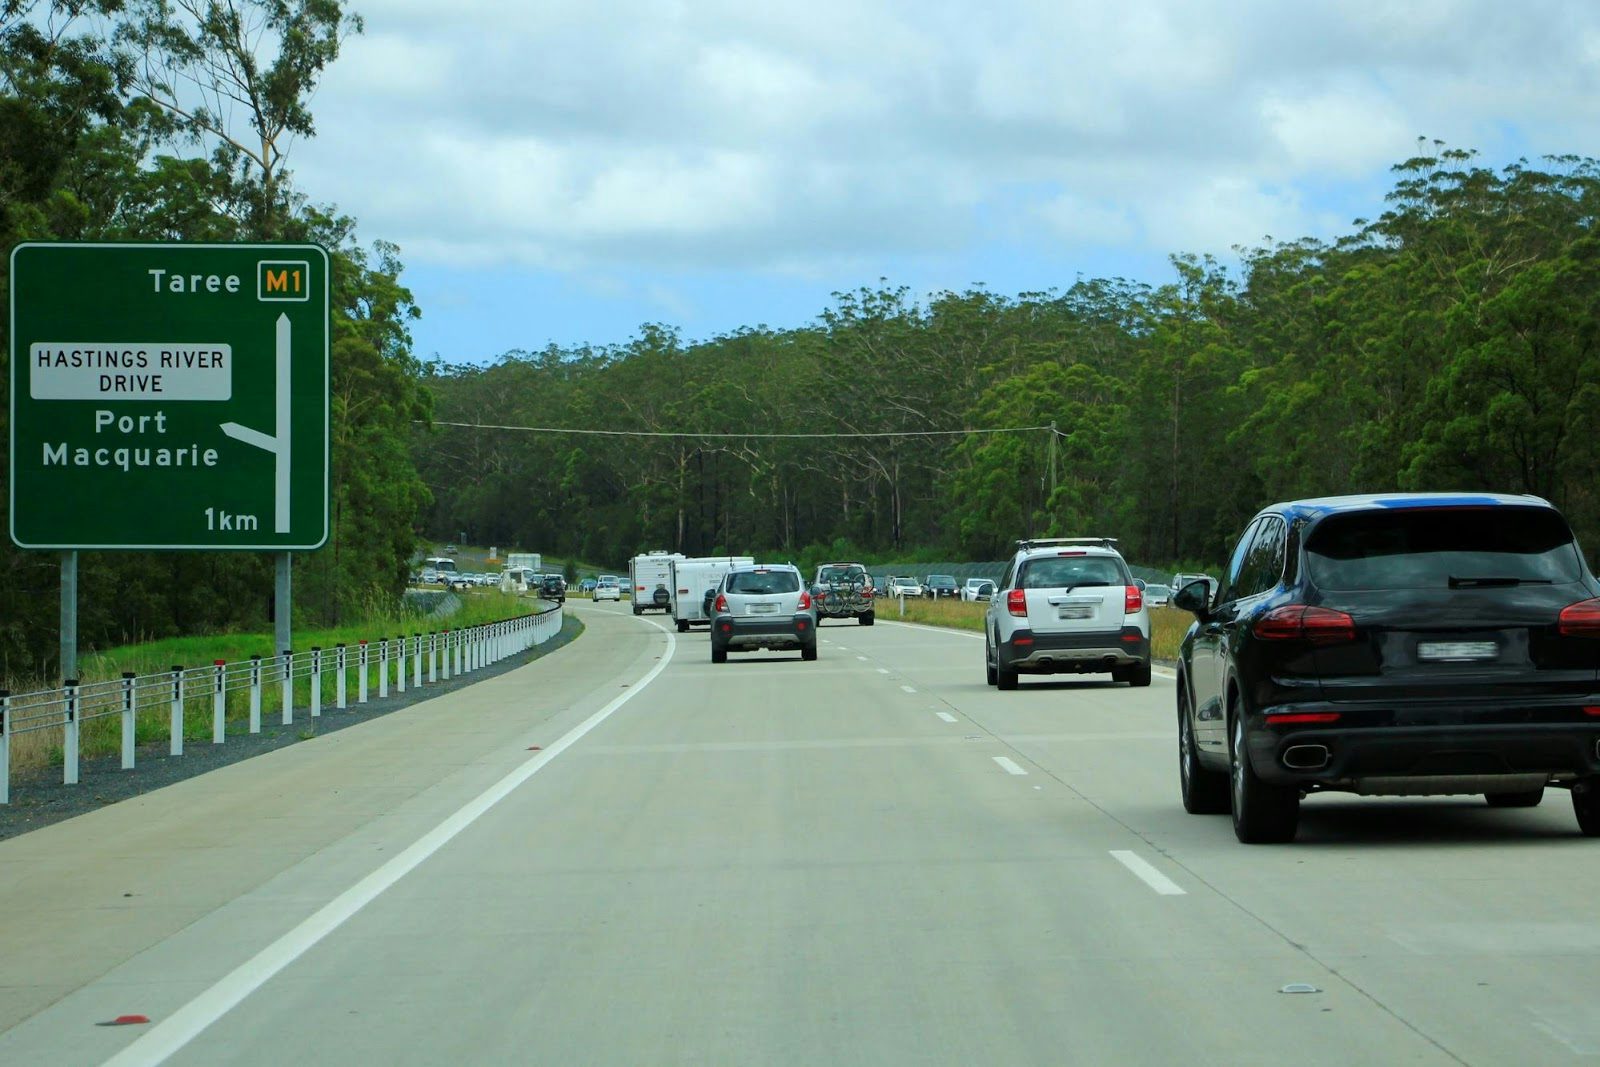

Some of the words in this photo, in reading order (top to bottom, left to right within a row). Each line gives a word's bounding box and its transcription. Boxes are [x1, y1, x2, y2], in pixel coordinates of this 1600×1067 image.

[148, 269, 241, 293] Taree
[266, 270, 301, 292] M1
[38, 350, 148, 368] HASTINGS
[160, 351, 223, 369] RIVER
[99, 375, 163, 392] DRIVE
[95, 410, 167, 434] Port
[43, 442, 219, 472] Macquarie
[204, 507, 258, 531] 1km
